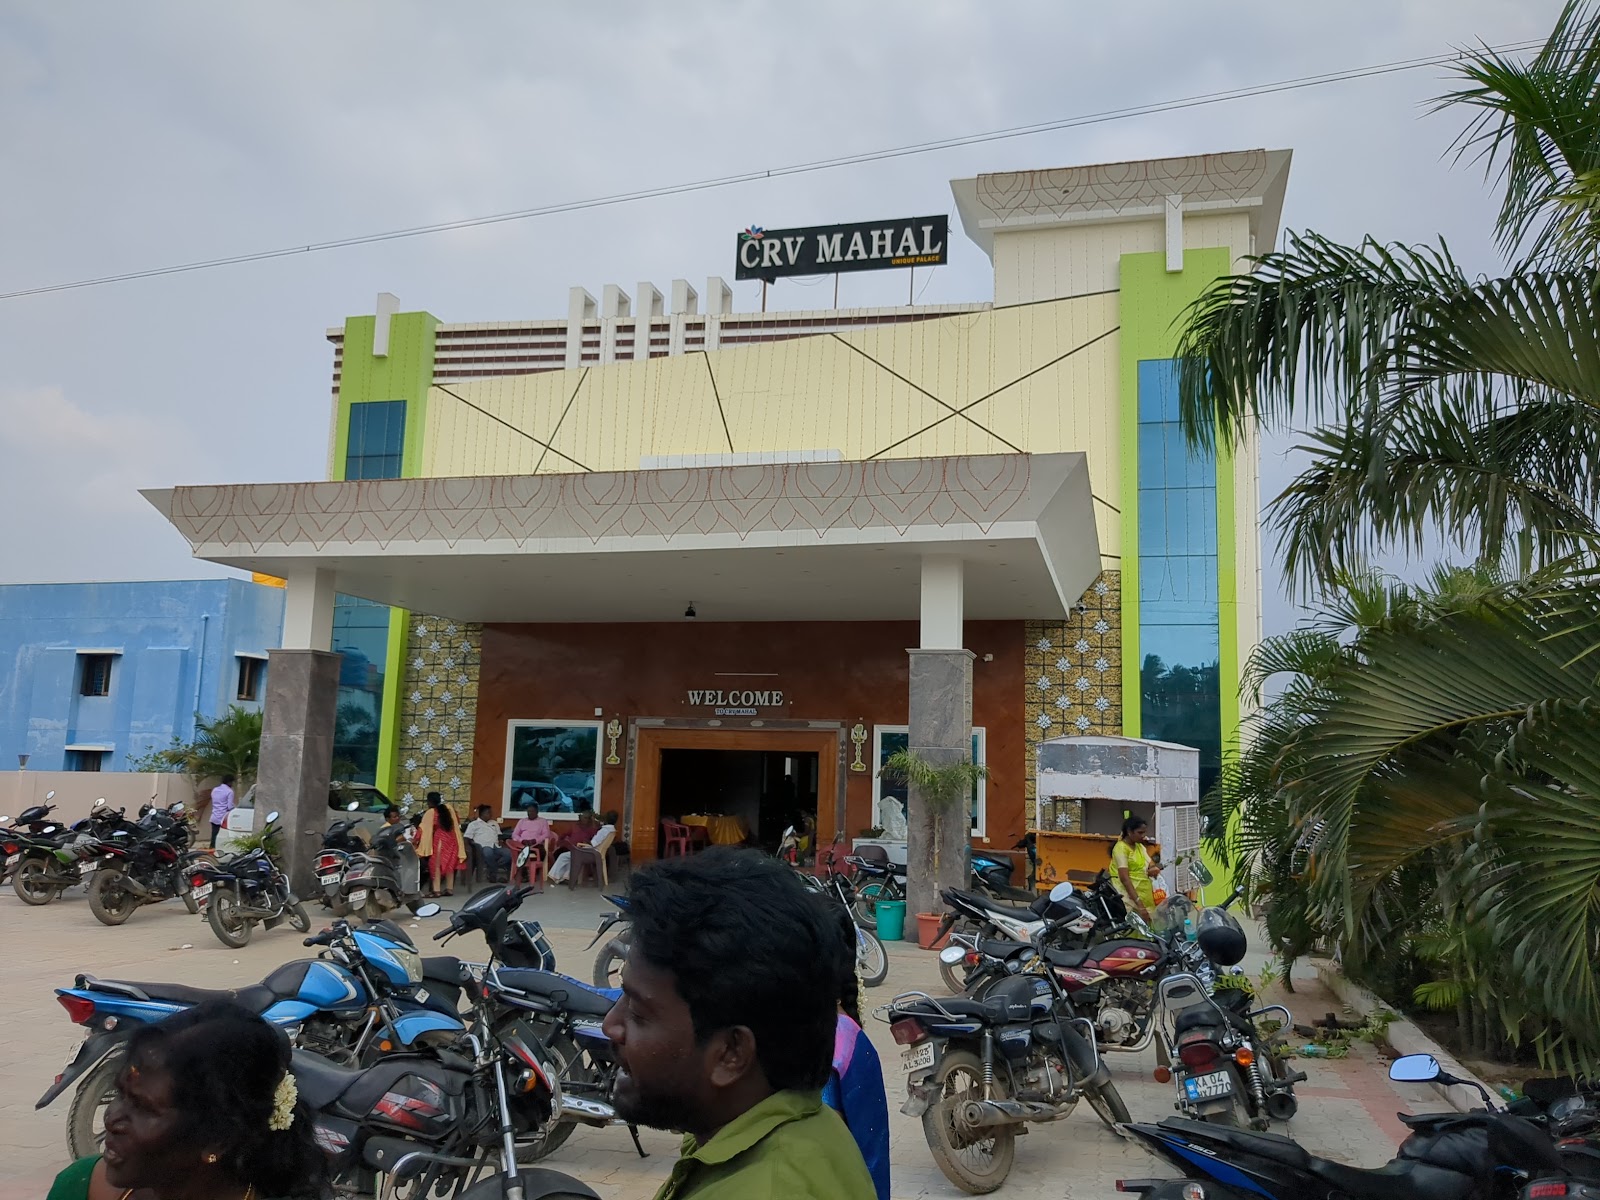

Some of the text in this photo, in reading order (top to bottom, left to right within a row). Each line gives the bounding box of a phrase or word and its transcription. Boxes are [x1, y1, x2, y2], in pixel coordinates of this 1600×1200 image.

[740, 225, 942, 268] CRV MAHAL
[687, 690, 784, 706] WELCOME
[1195, 1073, 1223, 1087] KA 04
